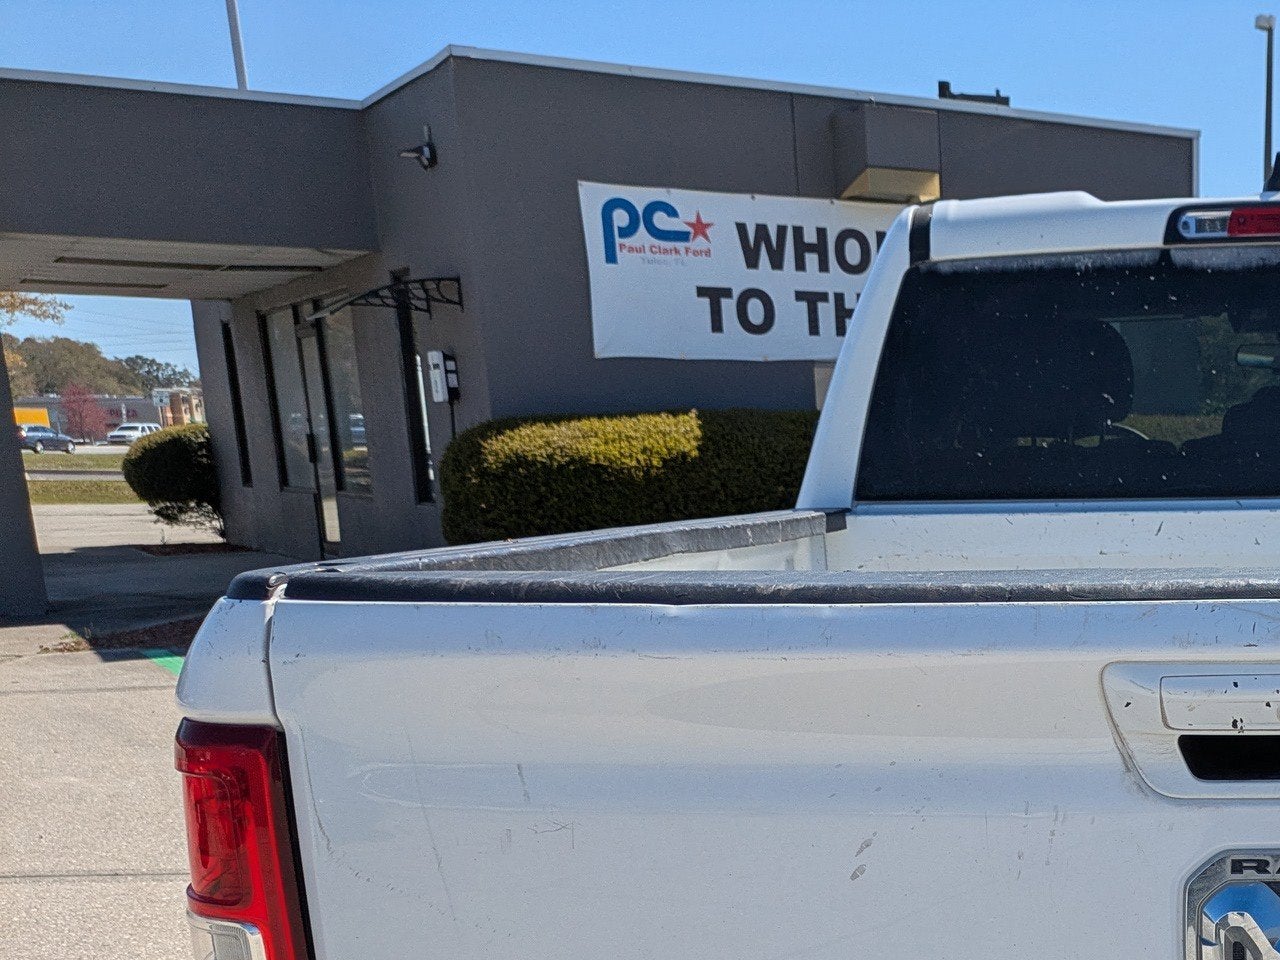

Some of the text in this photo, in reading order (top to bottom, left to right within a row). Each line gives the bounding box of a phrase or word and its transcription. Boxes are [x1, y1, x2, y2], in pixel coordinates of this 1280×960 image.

[618, 243, 712, 258] Paul Clark Ford
[735, 221, 887, 276] WHO
[696, 285, 776, 336] TO
